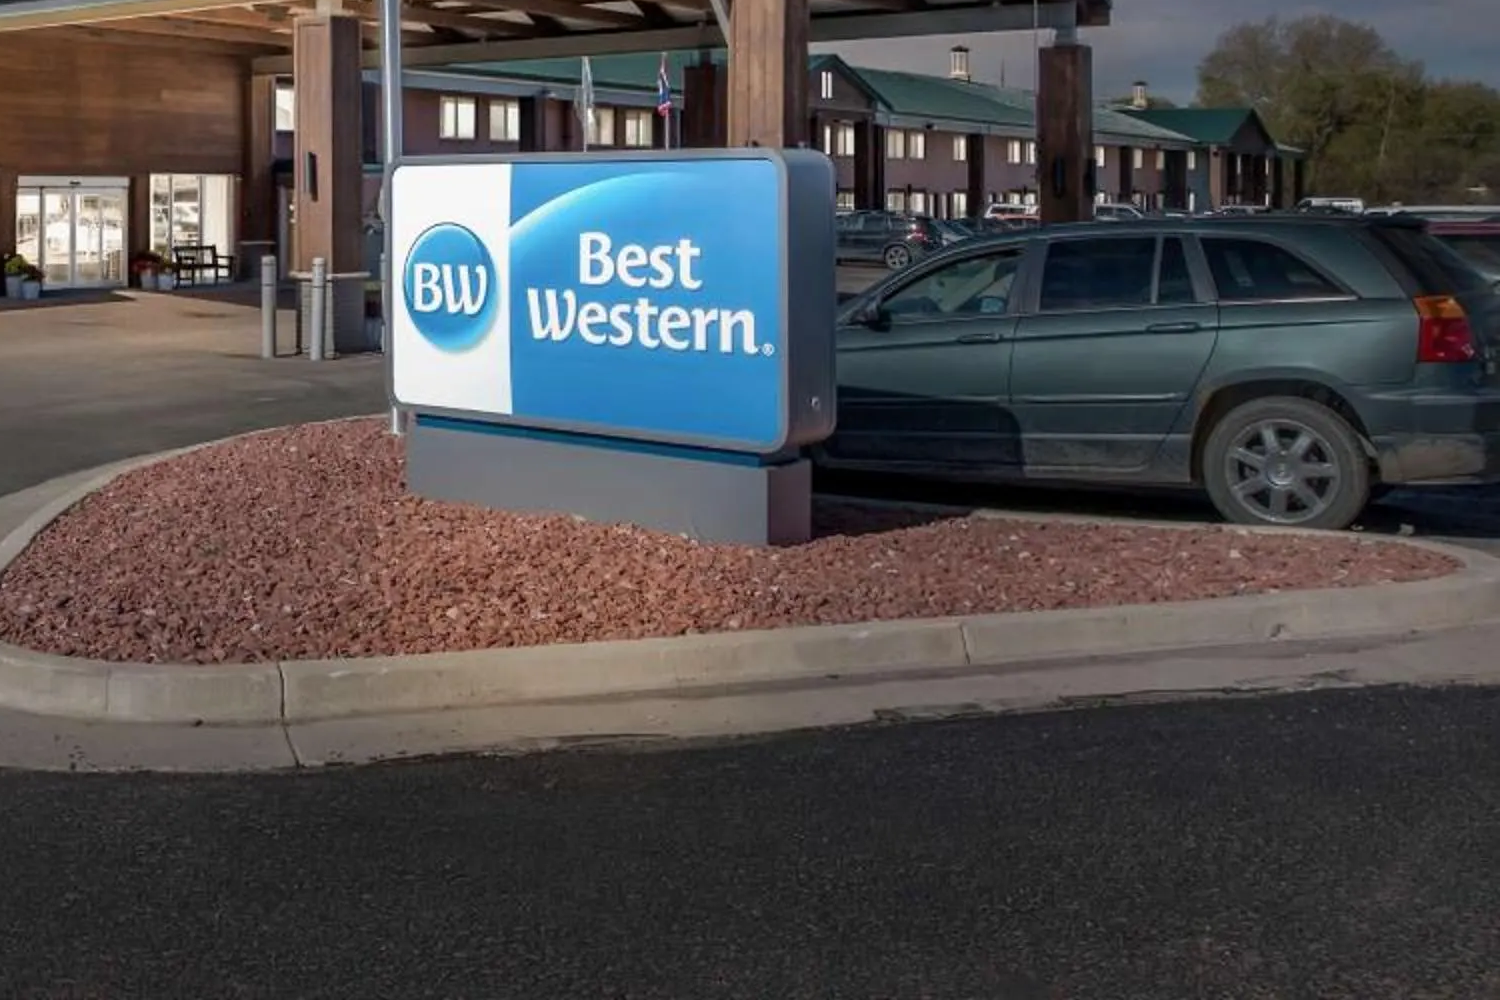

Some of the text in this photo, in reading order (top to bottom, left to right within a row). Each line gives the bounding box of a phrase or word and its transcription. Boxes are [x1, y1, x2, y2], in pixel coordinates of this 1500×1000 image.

[412, 262, 488, 316] BW
[579, 231, 702, 290] Best
[527, 287, 760, 356] Western
